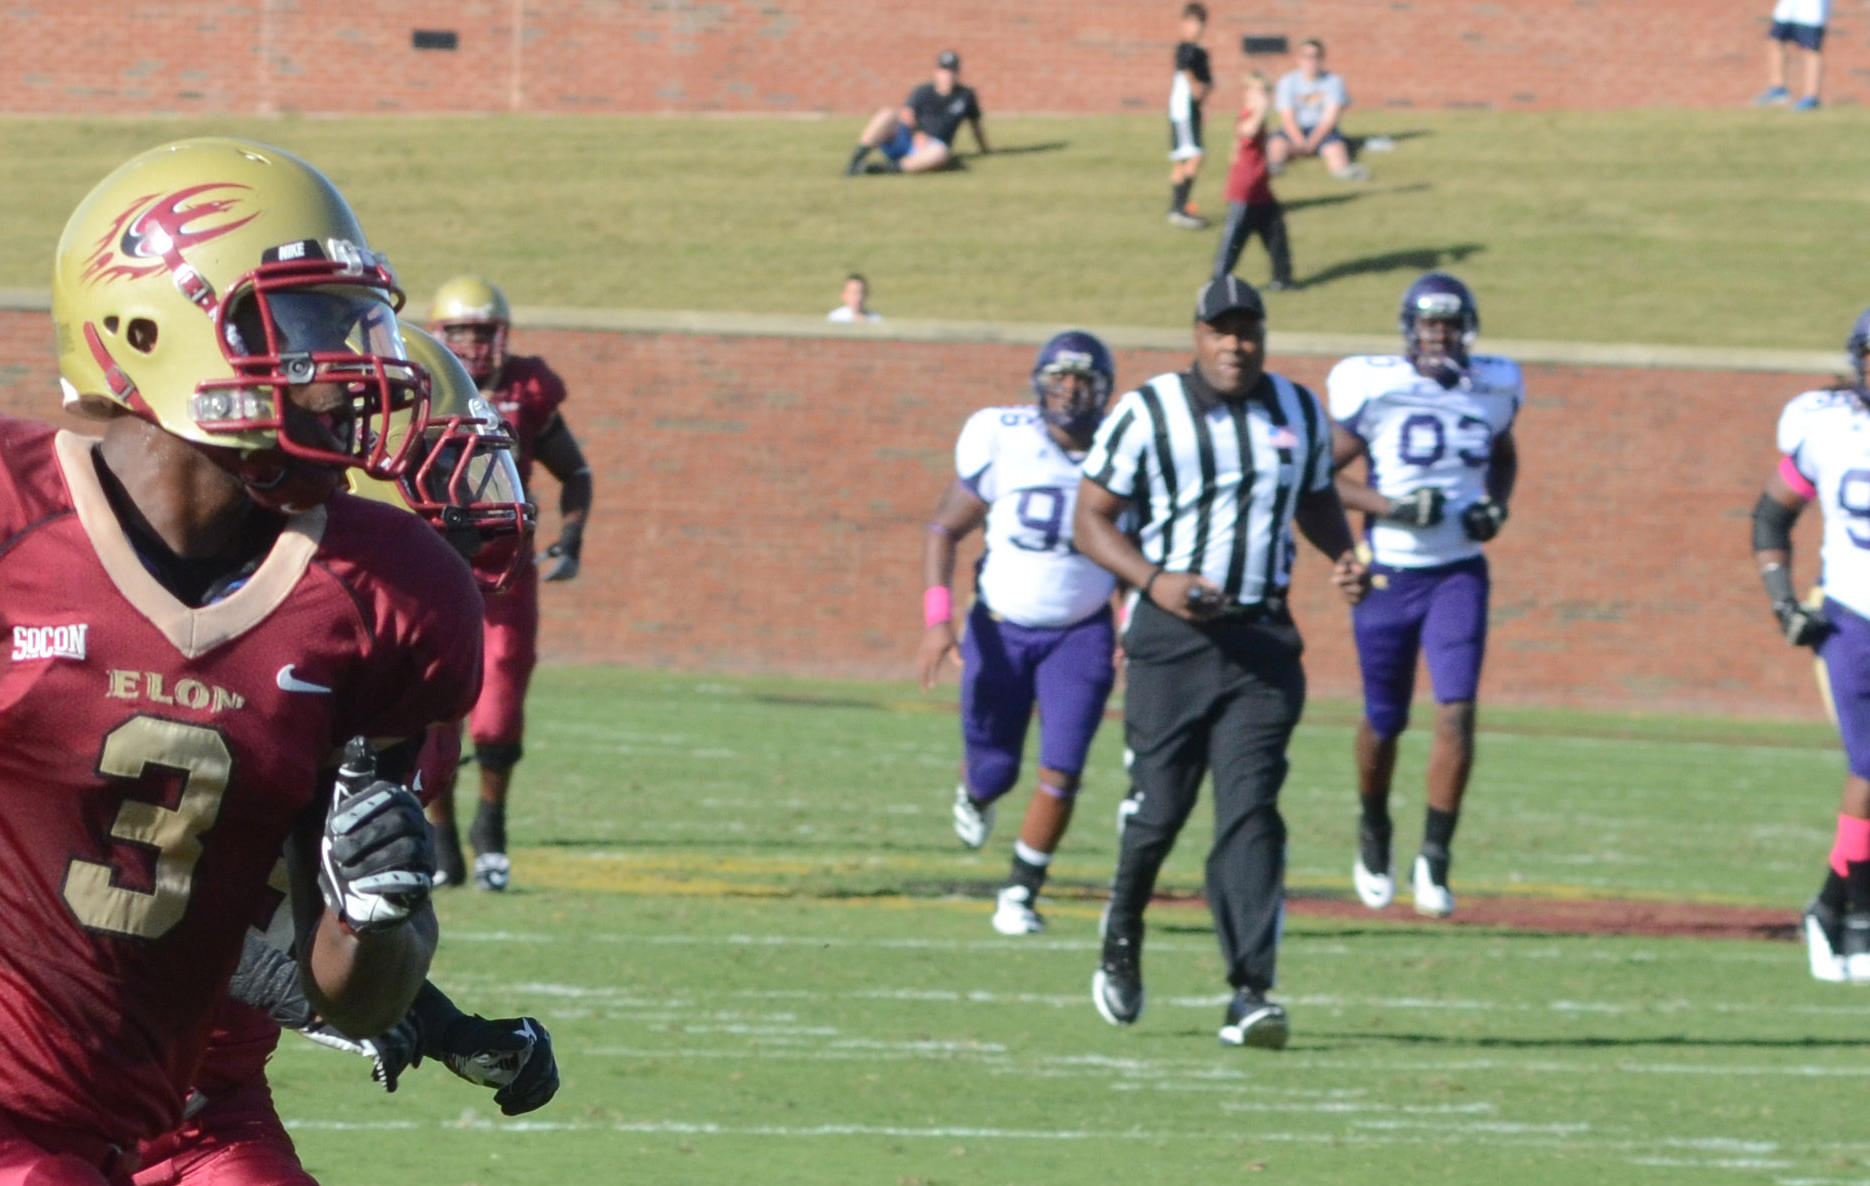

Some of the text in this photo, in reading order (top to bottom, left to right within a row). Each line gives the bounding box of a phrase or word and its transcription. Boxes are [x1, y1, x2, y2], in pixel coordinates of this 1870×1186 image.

[278, 241, 305, 261] NIKE
[12, 624, 88, 661] SOCON
[105, 669, 246, 714] ELON
[60, 711, 237, 943] 3
